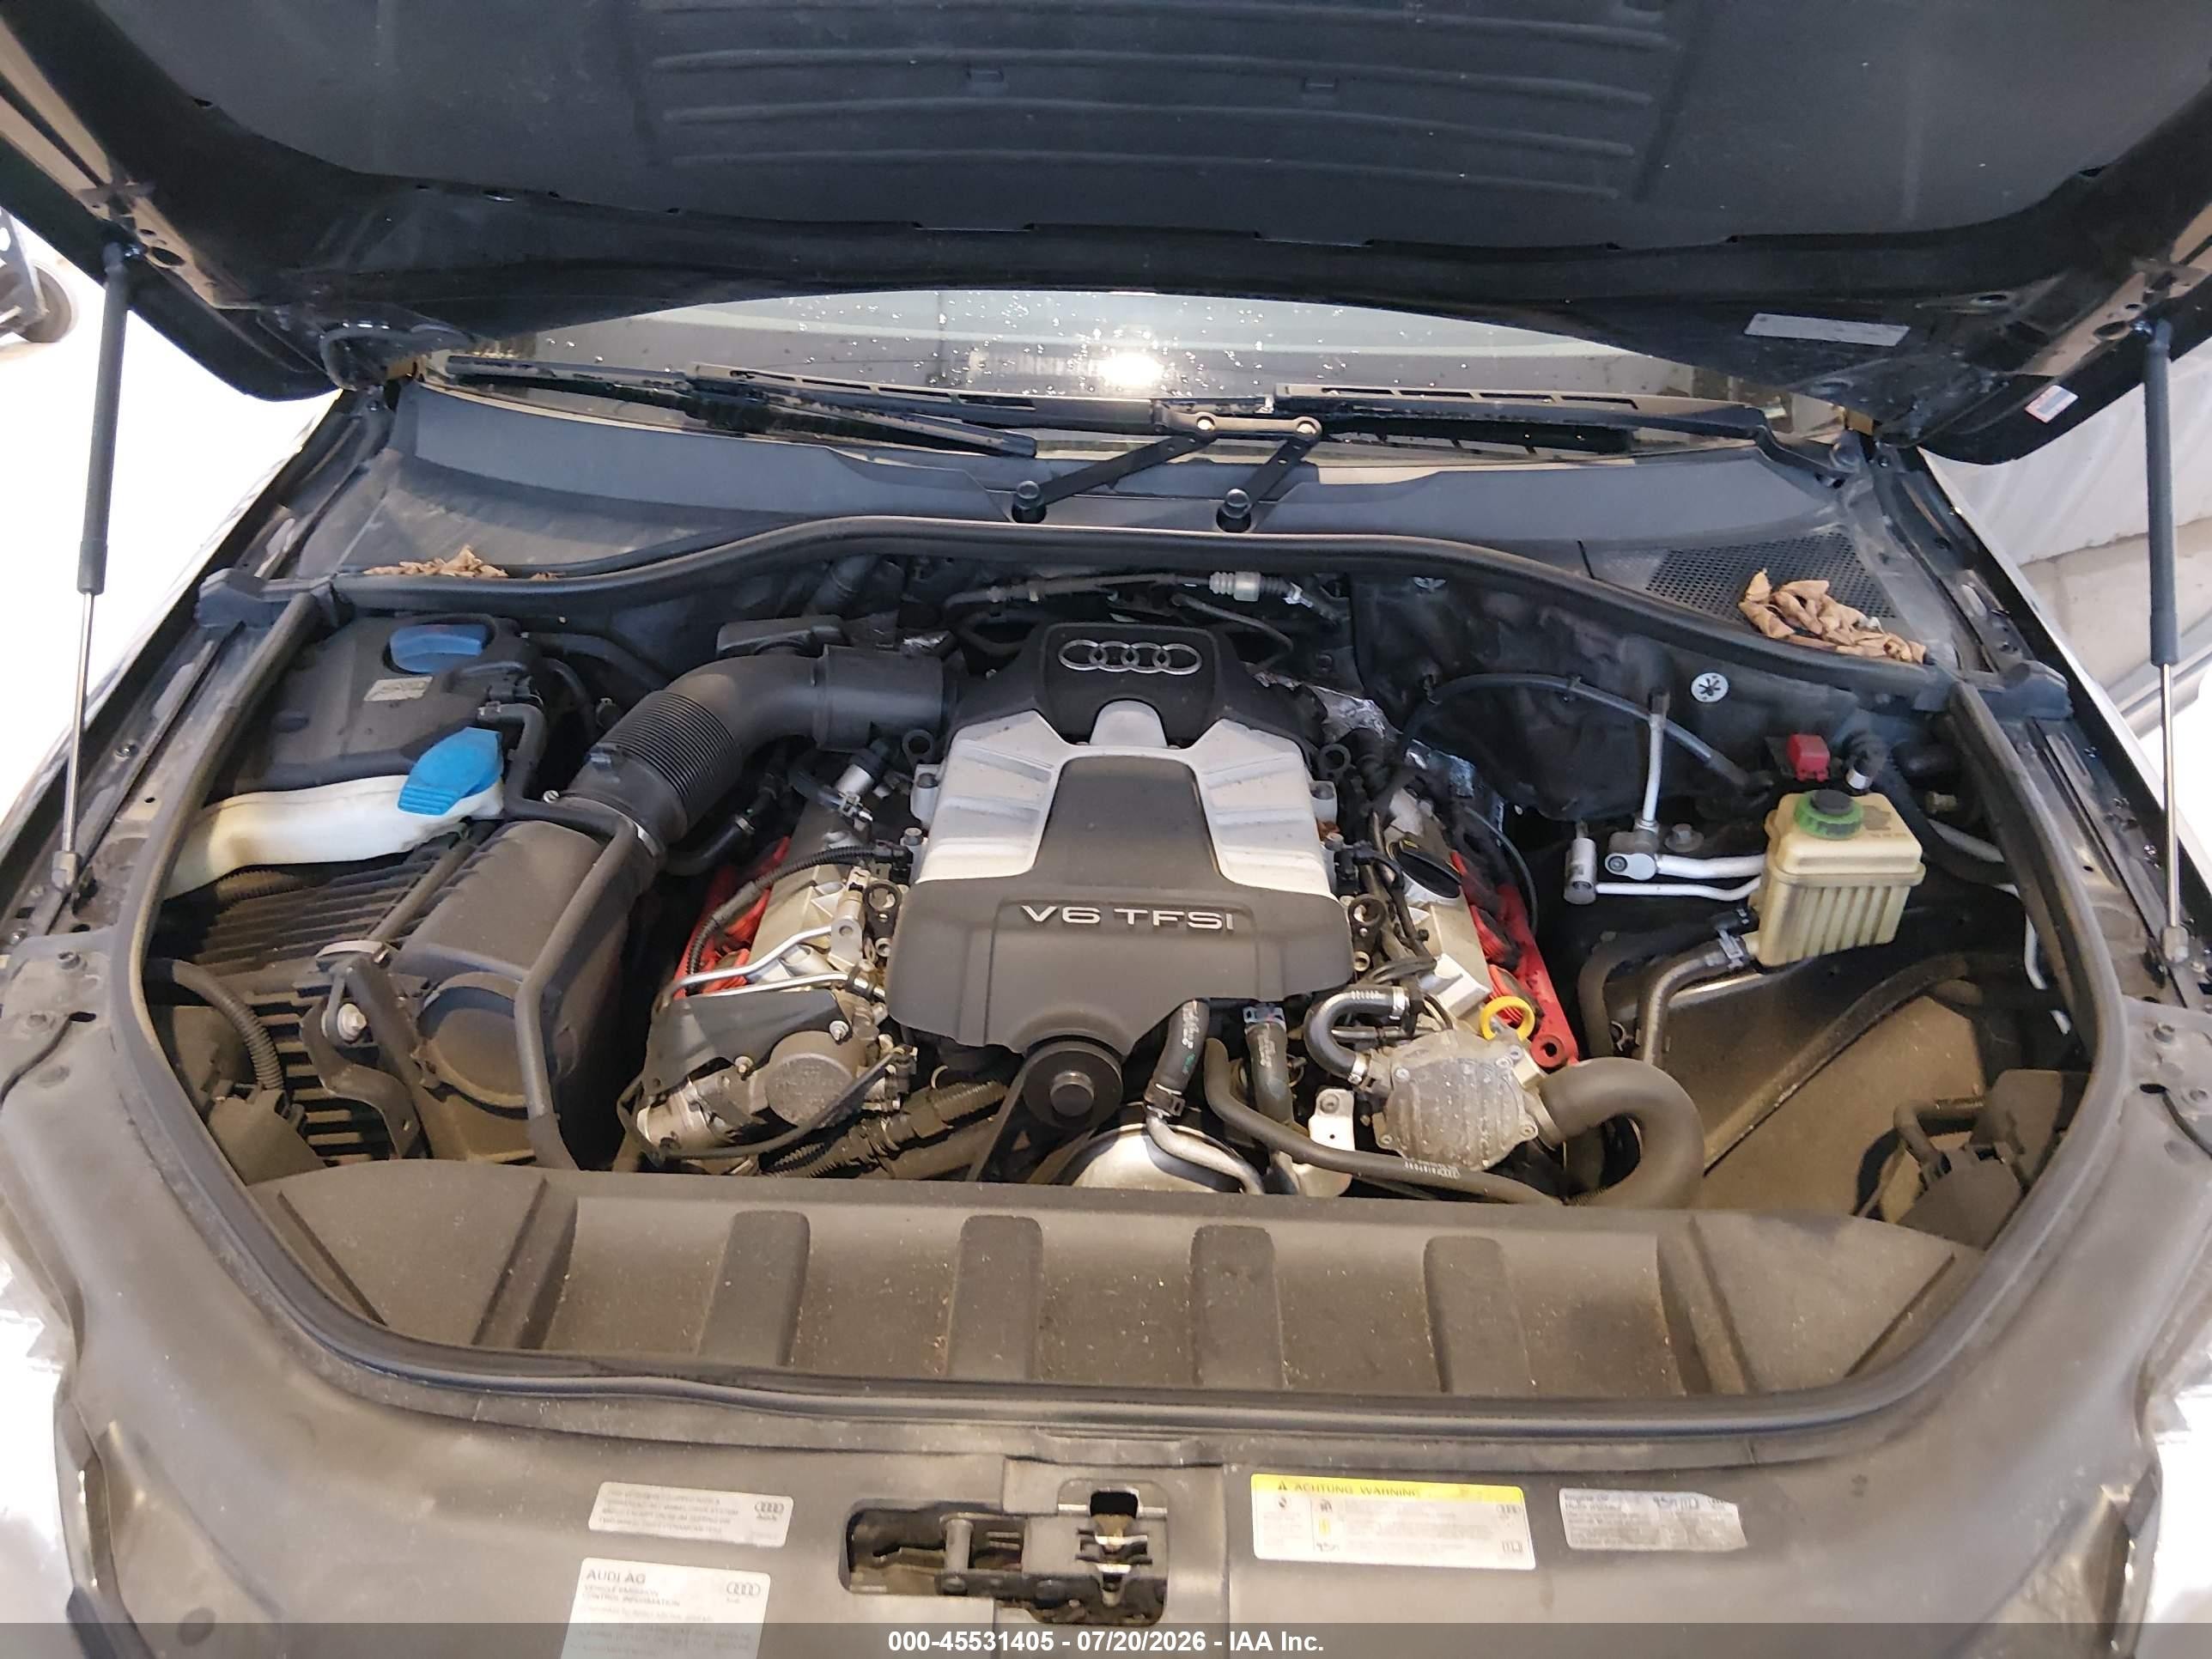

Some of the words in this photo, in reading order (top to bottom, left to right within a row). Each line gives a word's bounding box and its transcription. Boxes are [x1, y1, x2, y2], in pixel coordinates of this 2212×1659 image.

[1021, 905, 1102, 925] V6
[1113, 908, 1235, 930] TFSI
[1295, 1483, 1353, 1495] ACHTUNG
[1359, 1486, 1419, 1498] WARNING
[586, 1569, 621, 1583] AUDI
[624, 1571, 646, 1585] AG
